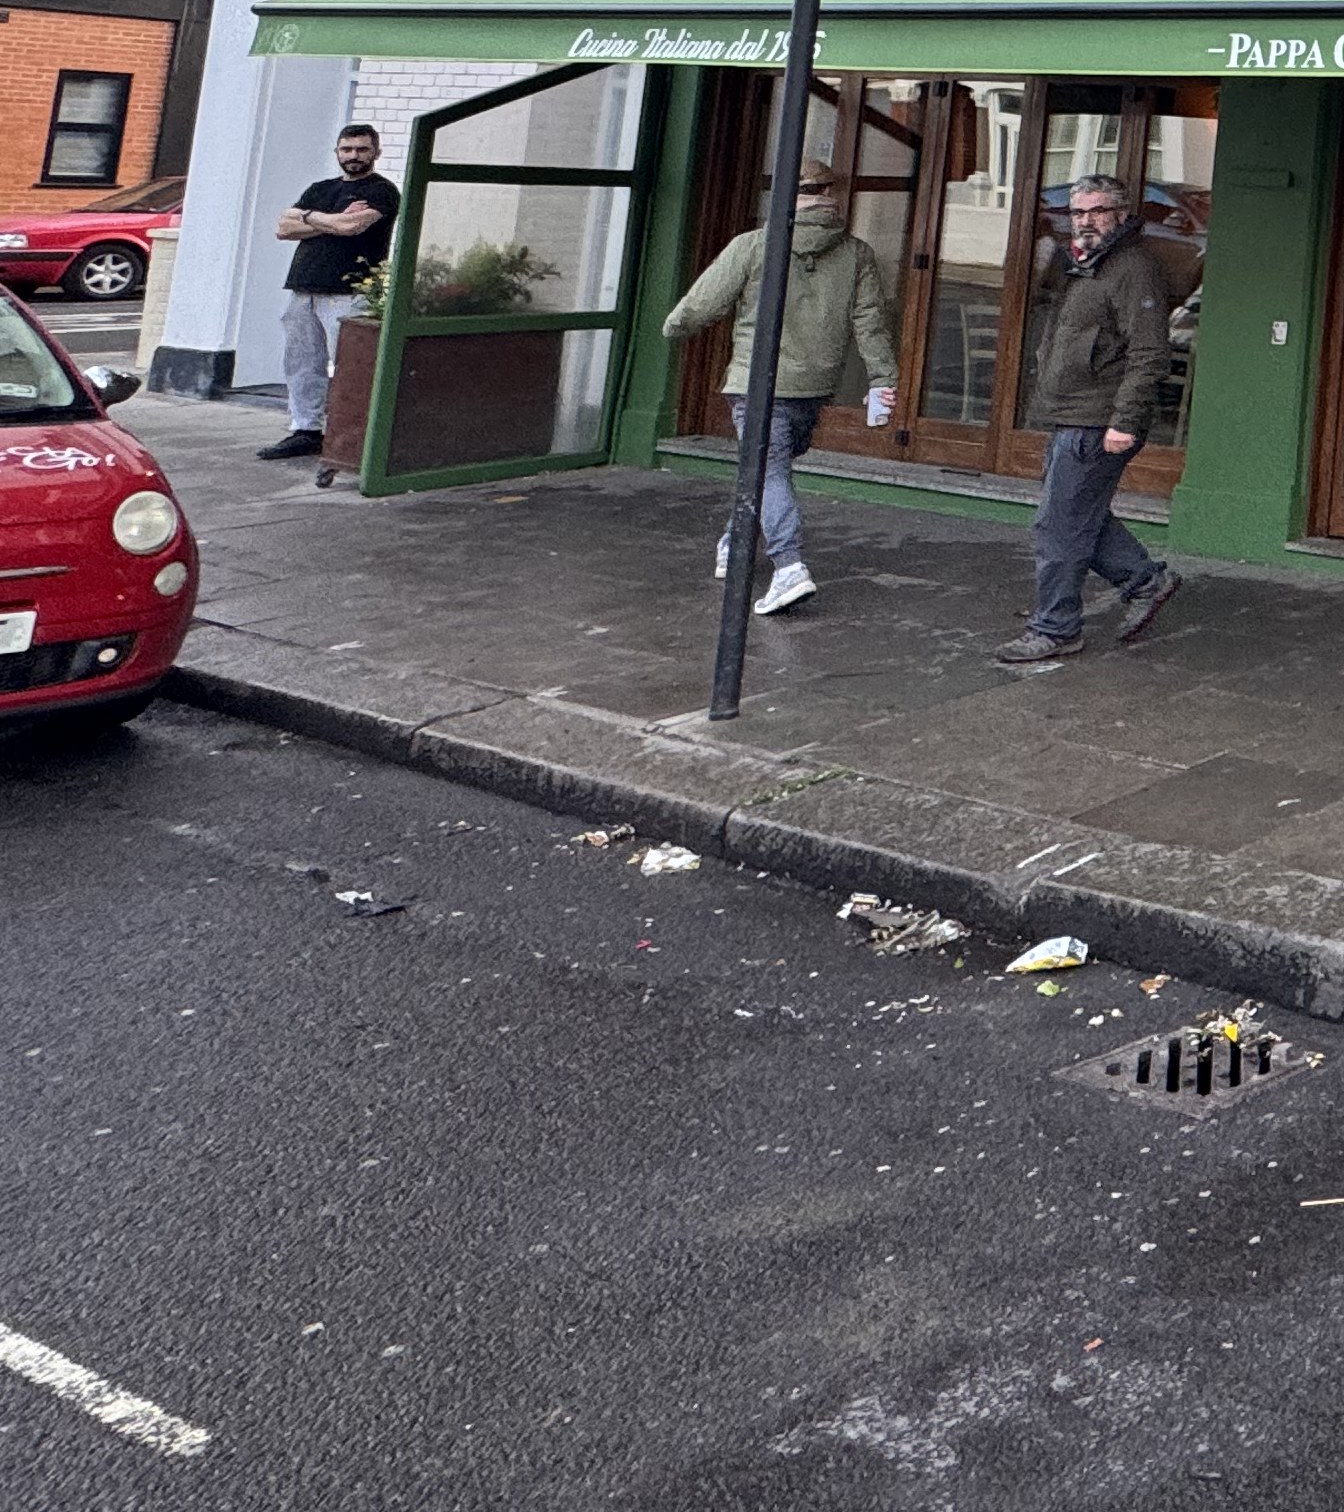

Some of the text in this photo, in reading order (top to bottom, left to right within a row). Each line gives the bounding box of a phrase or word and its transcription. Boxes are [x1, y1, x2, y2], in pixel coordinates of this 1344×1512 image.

[567, 28, 639, 58] Cucina
[641, 28, 728, 60] Italiana
[724, 29, 767, 61] dal
